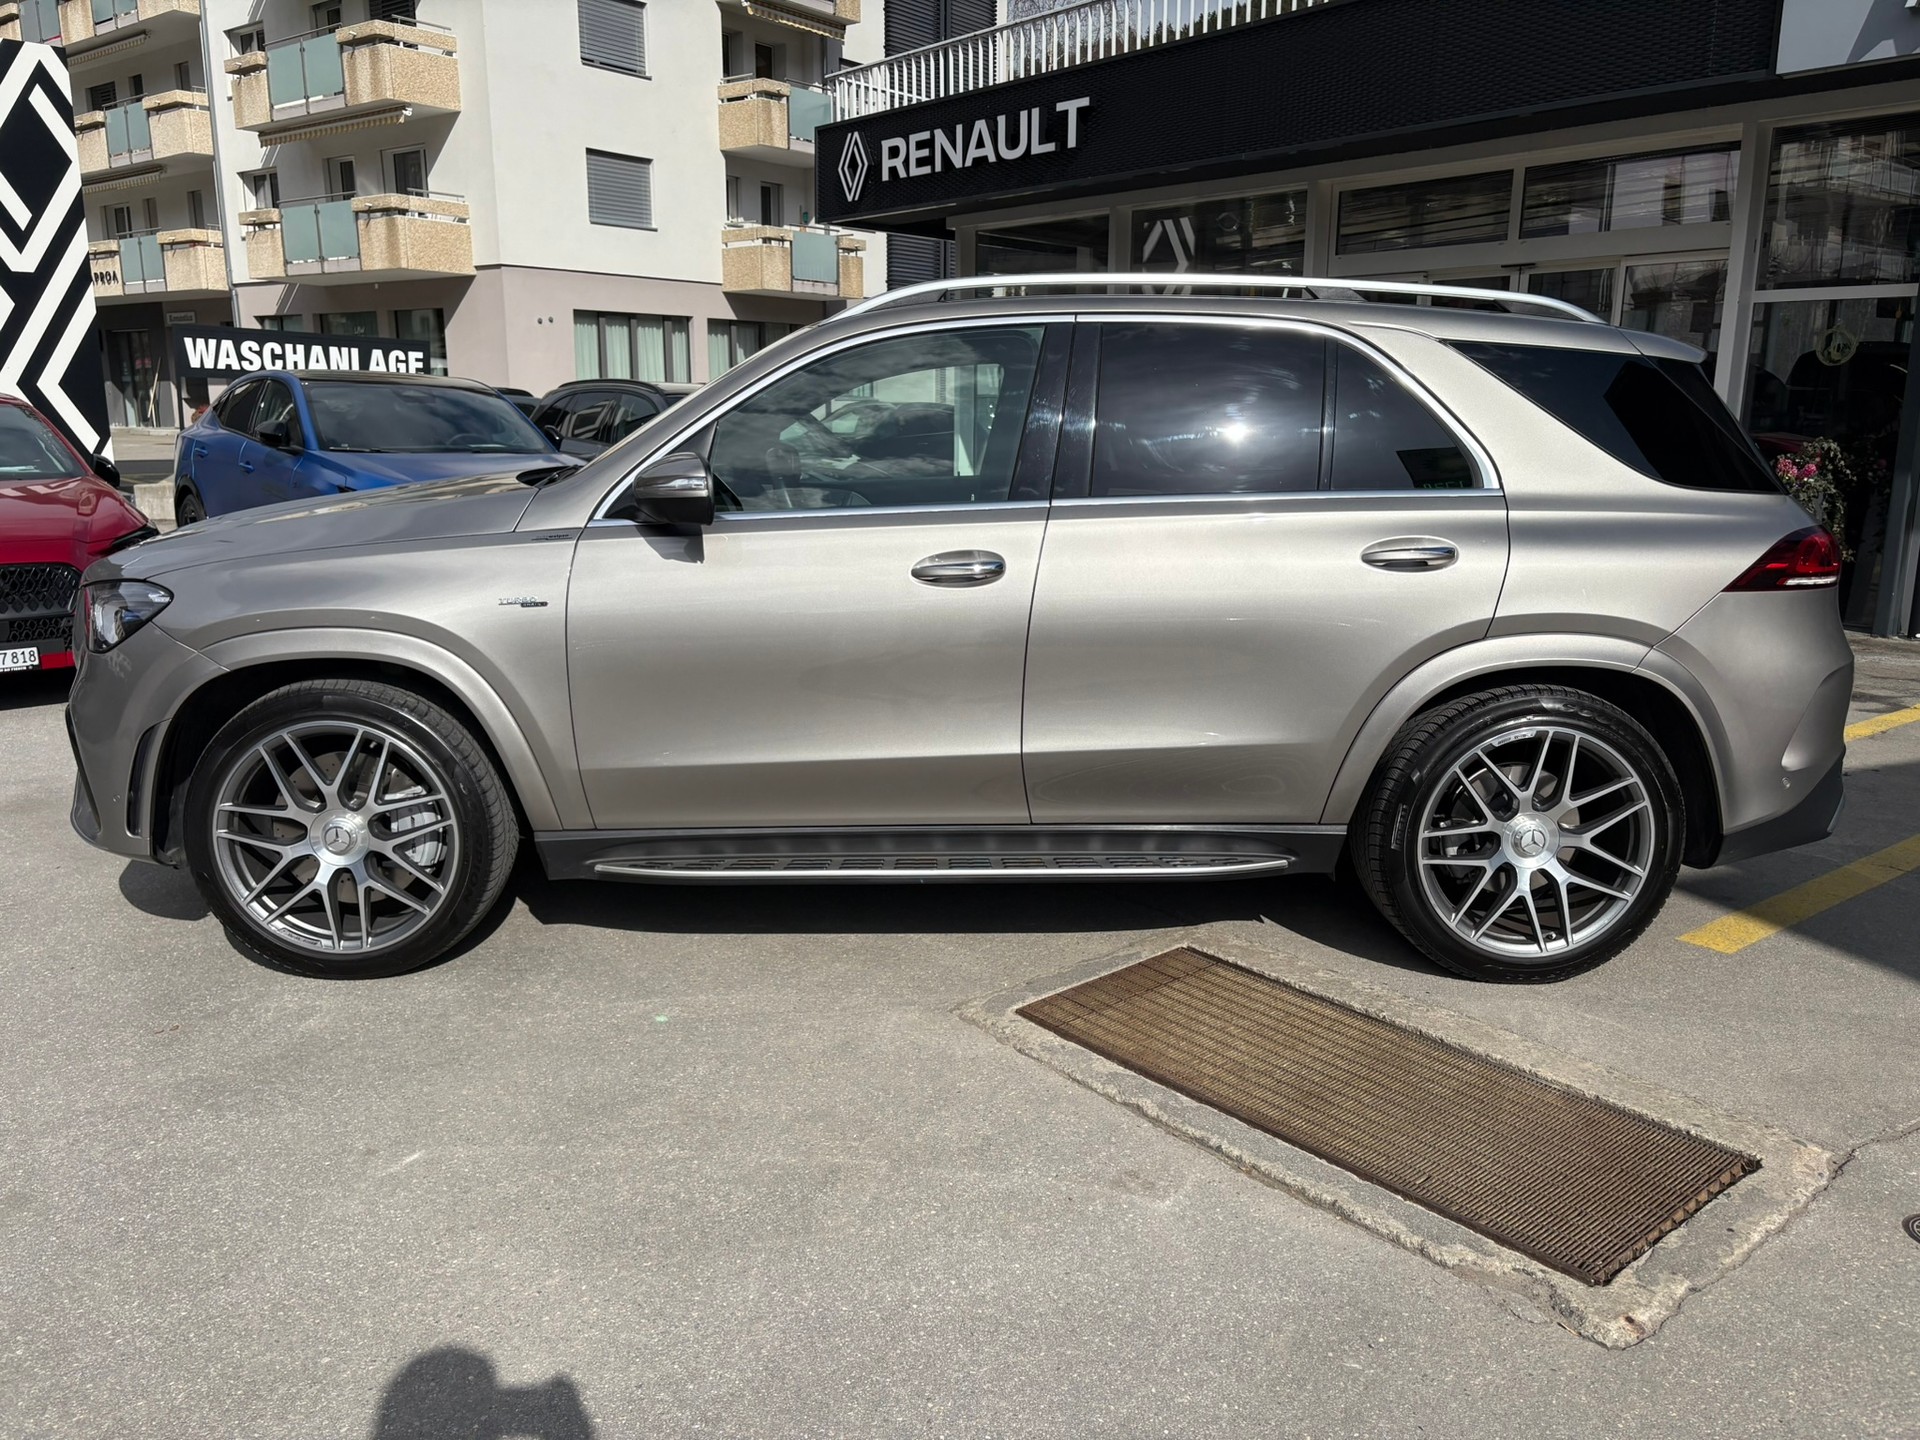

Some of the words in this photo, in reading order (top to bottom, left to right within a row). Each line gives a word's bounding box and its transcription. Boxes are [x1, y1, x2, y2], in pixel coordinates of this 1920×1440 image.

[881, 96, 1090, 182] RENAULT
[93, 270, 119, 286] PROA
[184, 336, 425, 374] WASCHANLAGE
[11, 650, 36, 664] 818
